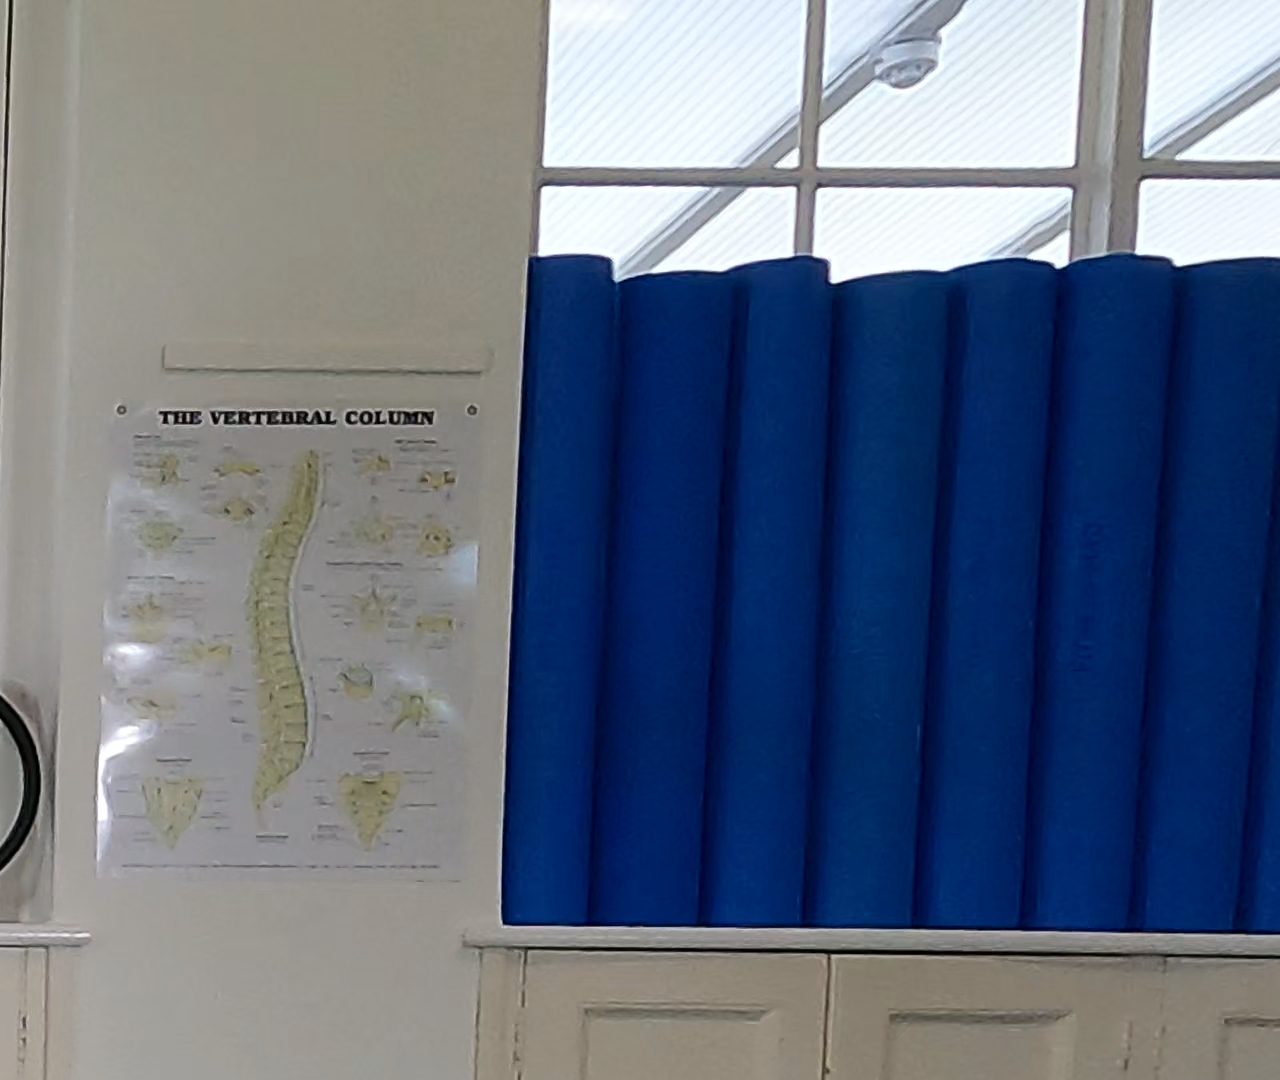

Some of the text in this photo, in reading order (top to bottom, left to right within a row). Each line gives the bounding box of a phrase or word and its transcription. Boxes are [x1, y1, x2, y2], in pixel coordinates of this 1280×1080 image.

[159, 410, 436, 425] THE VERTEBRAL COLUMN
